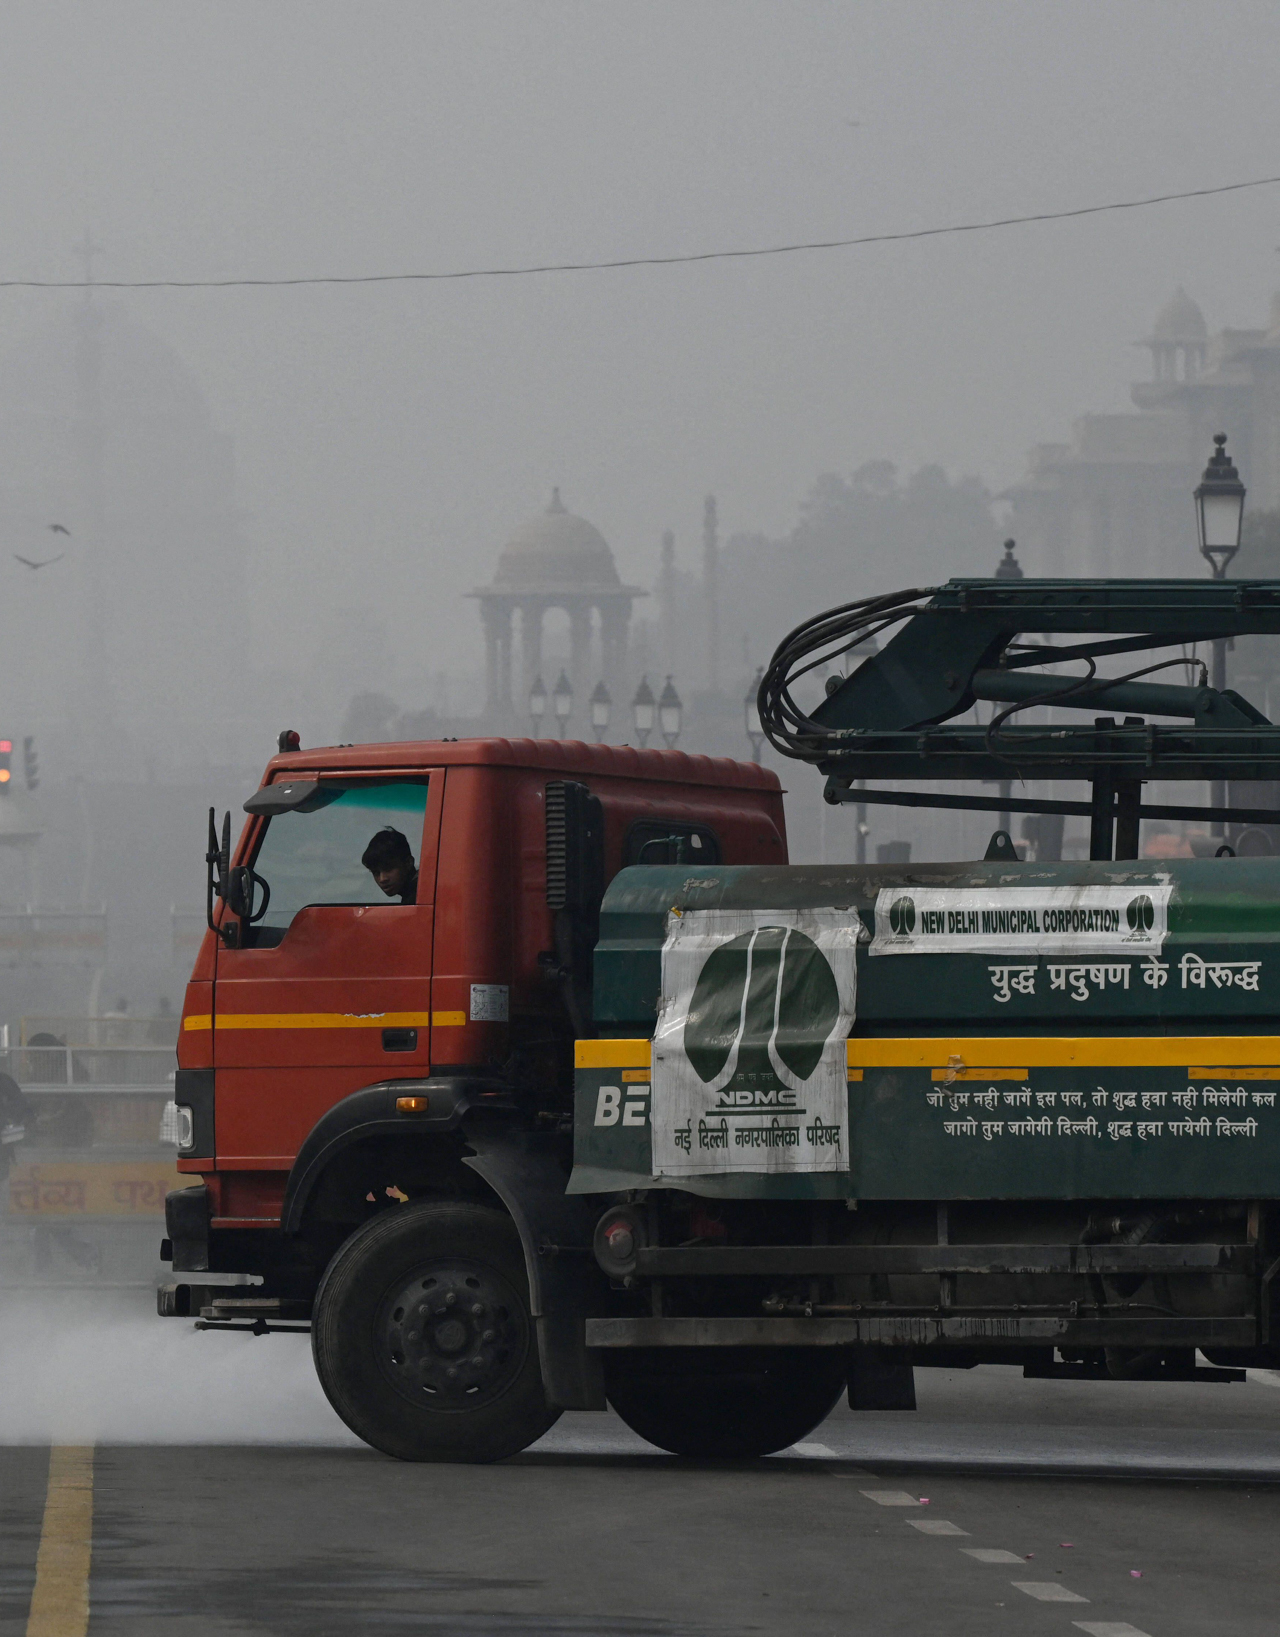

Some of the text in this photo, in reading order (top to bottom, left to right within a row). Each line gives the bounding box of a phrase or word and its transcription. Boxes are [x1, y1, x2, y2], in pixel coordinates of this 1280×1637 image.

[921, 909, 1120, 934] NEW DELHI MUNICIPAL CORPORATION
[987, 952, 1262, 1003] युद्ध प्रदुषण के विरूद्ध
[593, 1085, 652, 1127] BE
[719, 1090, 797, 1106] NDMC
[926, 1086, 945, 1107] जो
[973, 1086, 1000, 1111] नही
[1003, 1086, 1032, 1107] जागें
[1035, 1091, 1057, 1109] इस
[1060, 1091, 1087, 1109] पल,
[1091, 1086, 1109, 1107] तो
[1112, 1091, 1137, 1111] शुद्ध
[1141, 1091, 1167, 1111] हवा
[1172, 1086, 1199, 1111] नही
[1202, 1086, 1248, 1107] मिलेगी
[1251, 1091, 1277, 1107] कल
[674, 1116, 841, 1155] नई दिल्ली नगरपालिका परिषद्
[943, 1115, 1258, 1141] जागो तुम जागेगी दिल्ली, शुद्ध हवा पायेगी दिल्ली
[10, 1163, 87, 1211] र्तव्य
